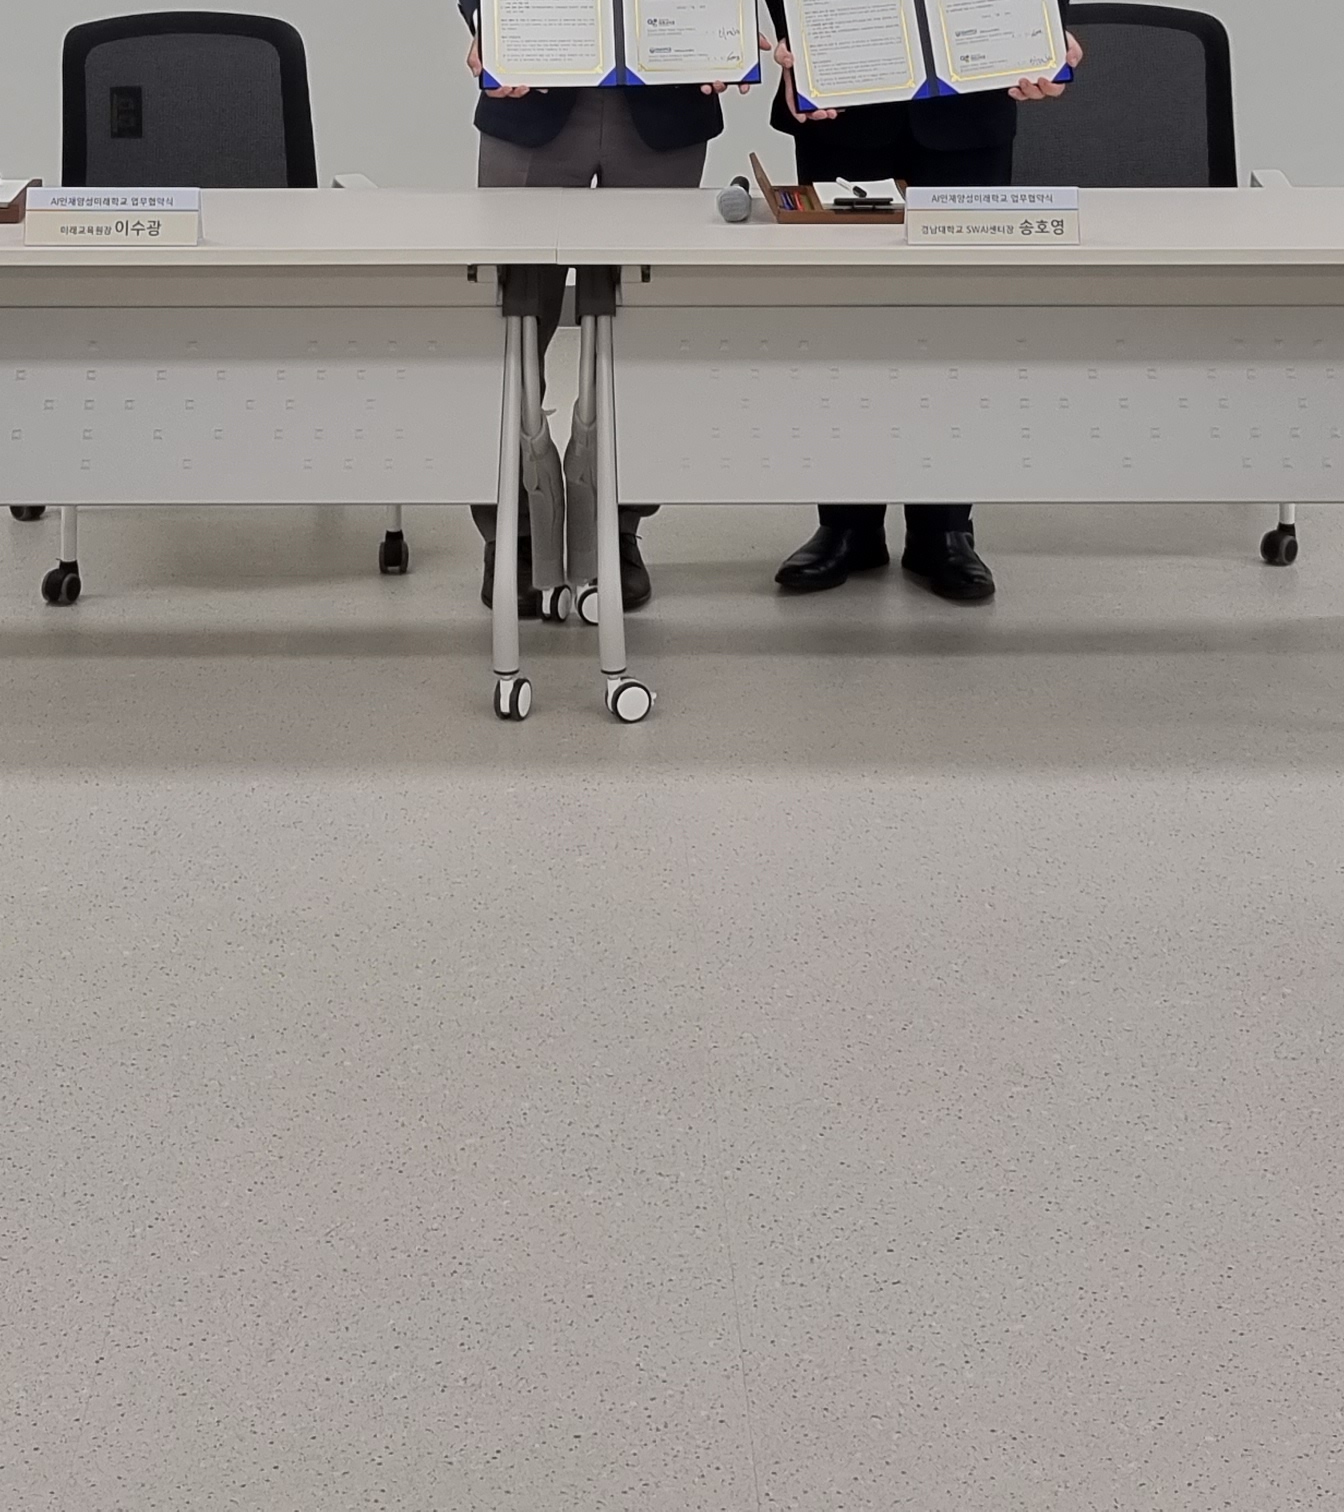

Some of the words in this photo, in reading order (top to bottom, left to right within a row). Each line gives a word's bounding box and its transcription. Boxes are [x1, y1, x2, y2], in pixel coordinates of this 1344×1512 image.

[50, 197, 129, 207] AI인재양성미래학교
[130, 196, 174, 207] 업무협약식
[931, 194, 1008, 204] AI인재양성미래학교
[1011, 193, 1054, 204] 업무협약식
[60, 225, 112, 235] 미래교육원장
[114, 219, 162, 237] 이수광
[921, 225, 964, 235] 경남대학교
[966, 225, 1014, 235] SWAI센터장
[1018, 218, 1065, 236] 송호영
